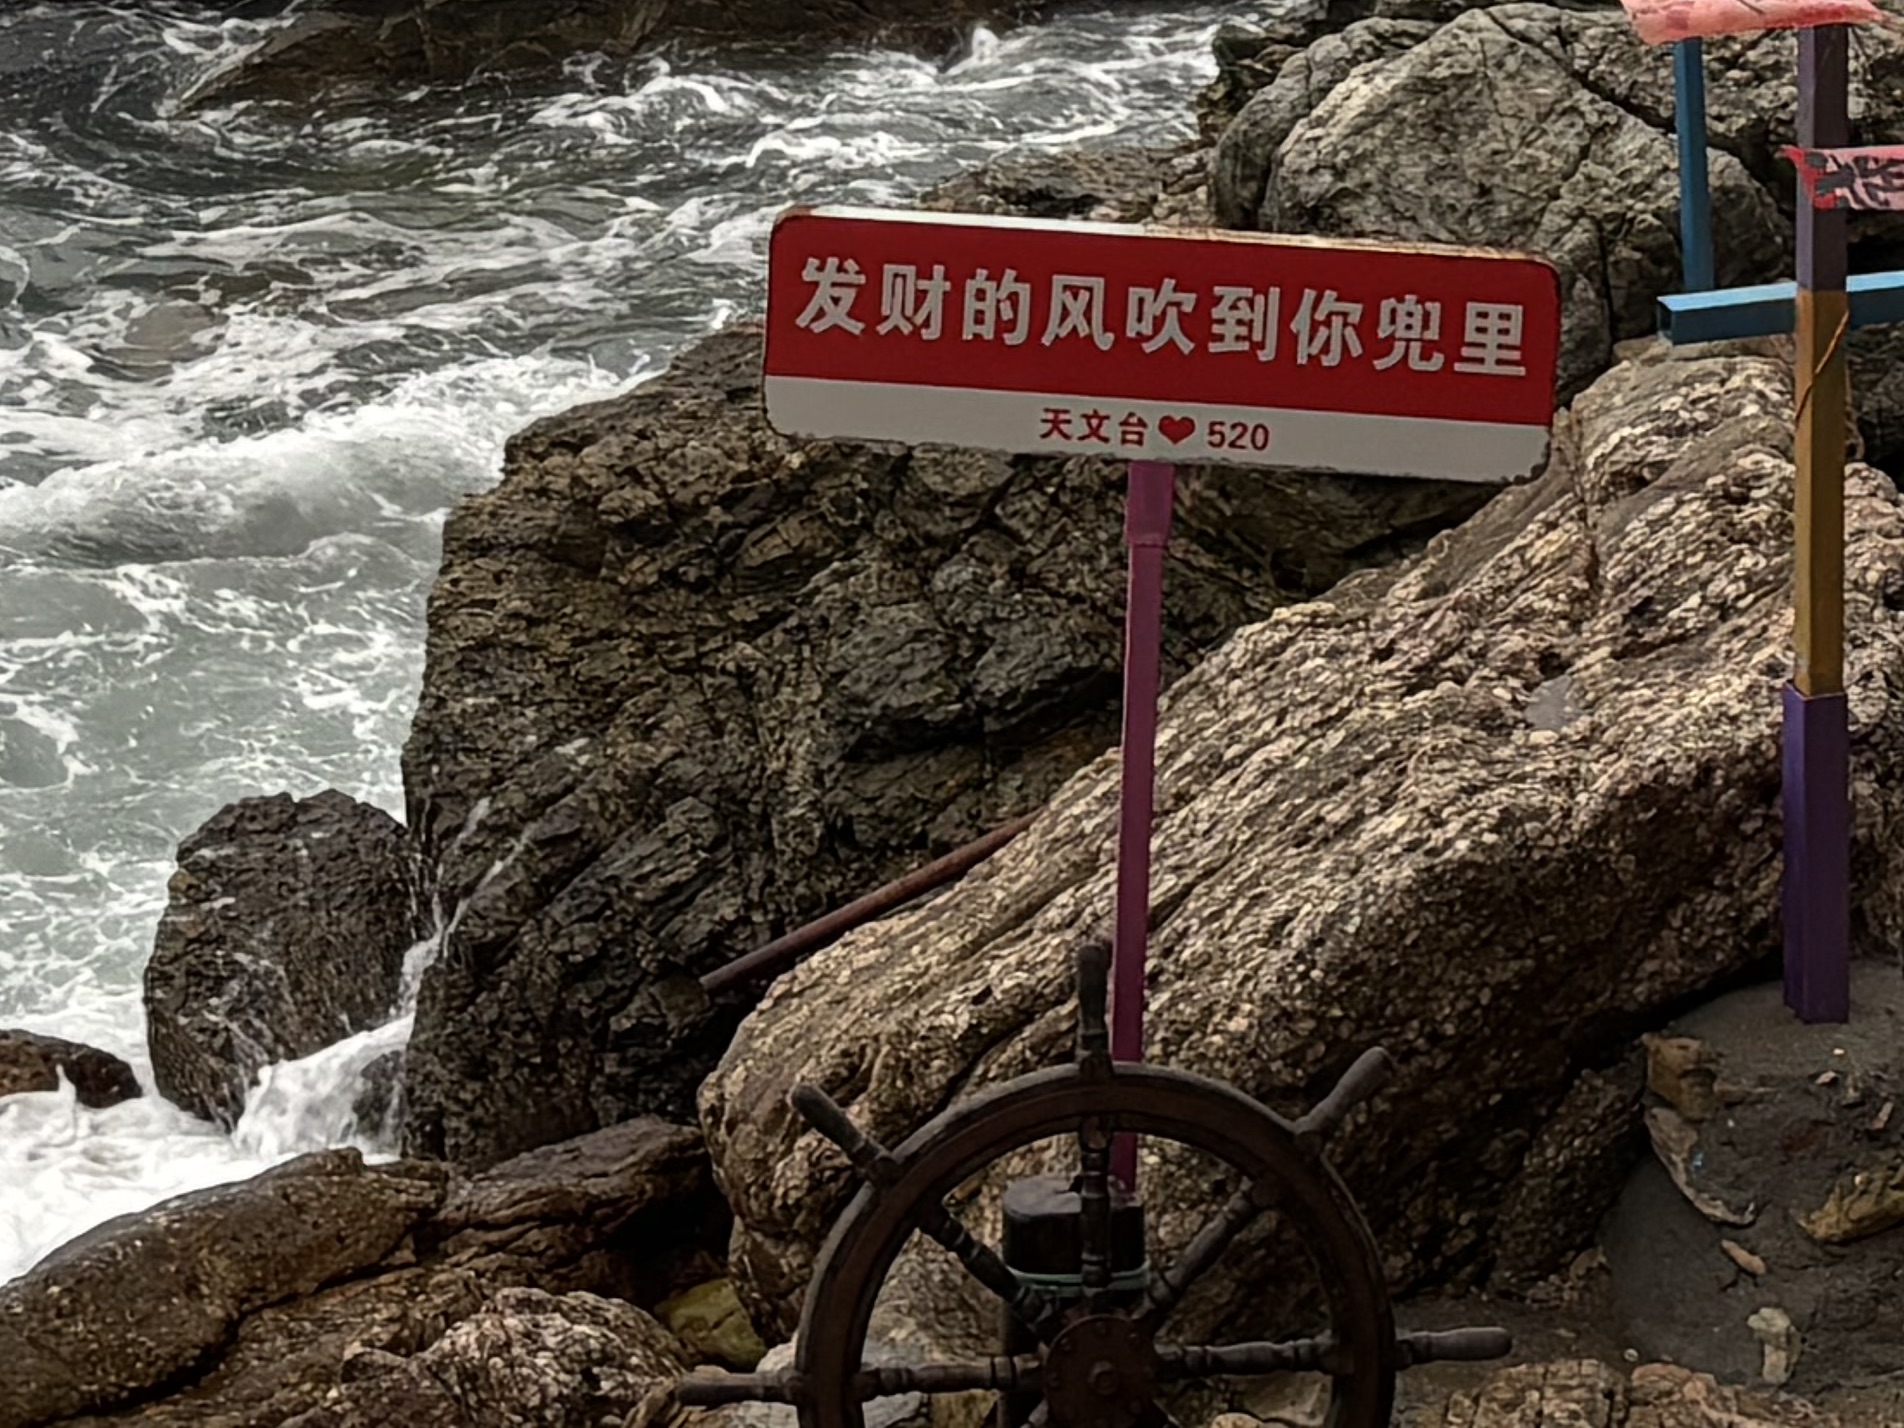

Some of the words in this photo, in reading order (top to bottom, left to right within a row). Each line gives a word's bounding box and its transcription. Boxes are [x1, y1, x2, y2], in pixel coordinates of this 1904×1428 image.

[794, 256, 1528, 378] 发财的风吹到你兜里
[1039, 407, 1148, 448] 天文台
[1207, 420, 1270, 451] 520
